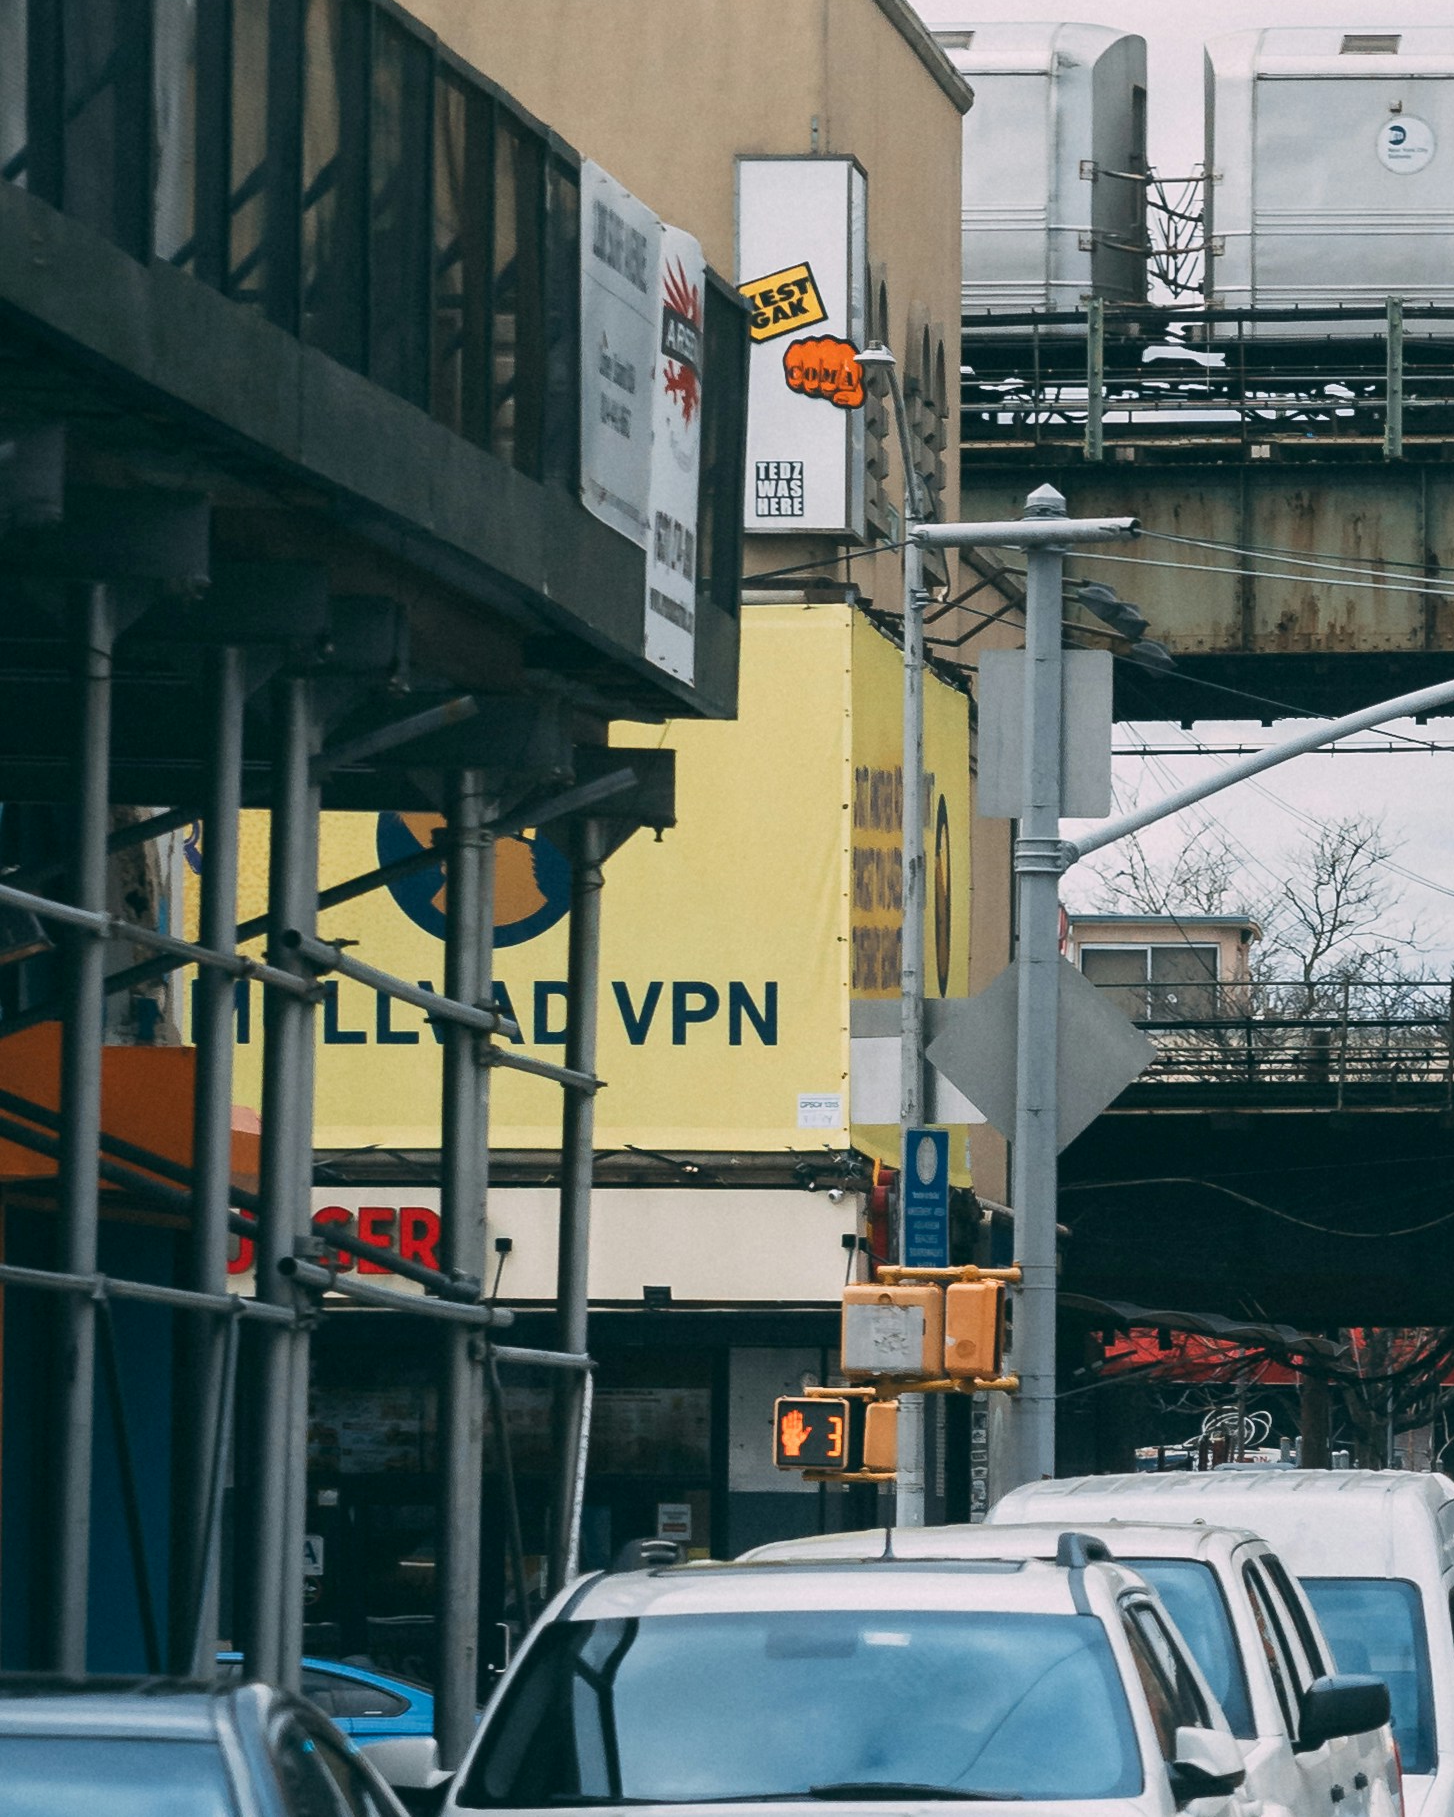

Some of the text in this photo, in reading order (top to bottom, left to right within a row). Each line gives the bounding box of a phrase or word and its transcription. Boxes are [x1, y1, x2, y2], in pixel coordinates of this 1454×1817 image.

[757, 462, 803, 480] TEDZ
[757, 480, 803, 497] WAS
[757, 498, 804, 516] HERE
[611, 980, 779, 1045] VPN
[826, 1416, 843, 1457] 3
